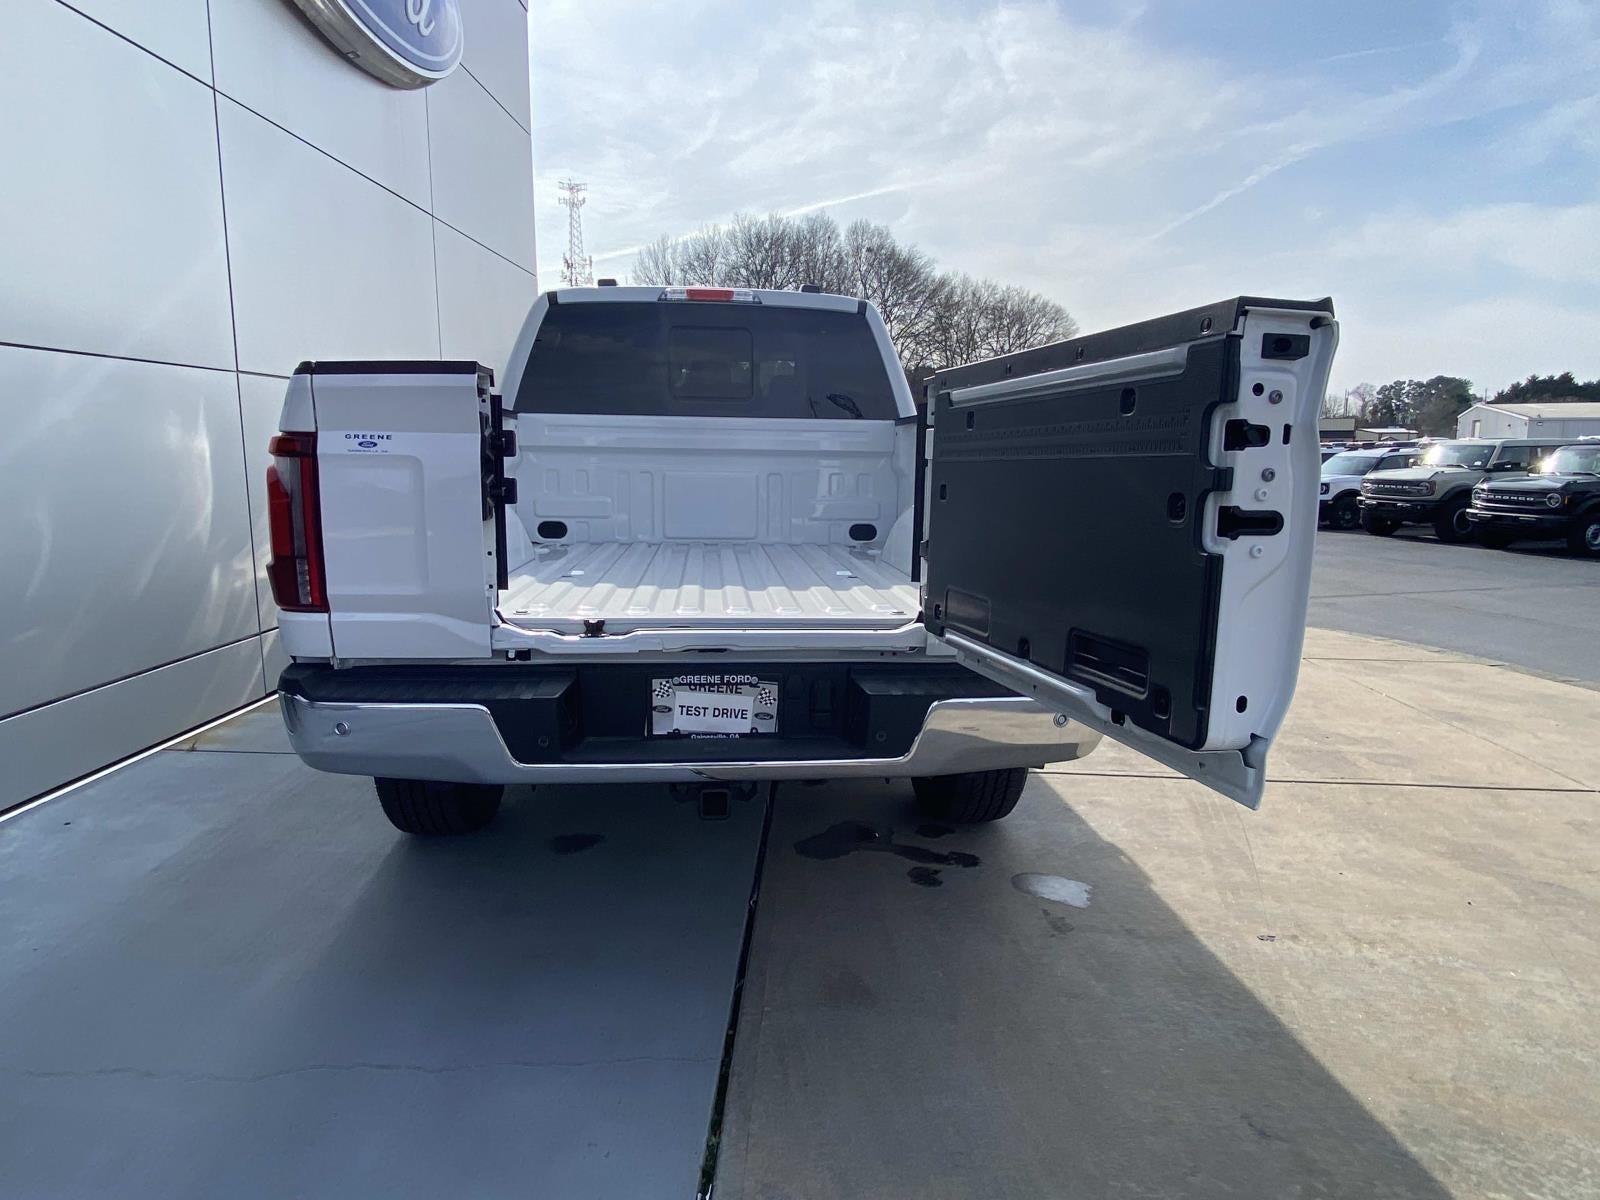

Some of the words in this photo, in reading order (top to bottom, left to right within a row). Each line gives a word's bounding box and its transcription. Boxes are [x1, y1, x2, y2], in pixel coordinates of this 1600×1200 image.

[680, 675, 721, 684] GREENE
[724, 675, 751, 684] FORD
[678, 705, 709, 717] TEST
[712, 707, 748, 720] DRIVE
